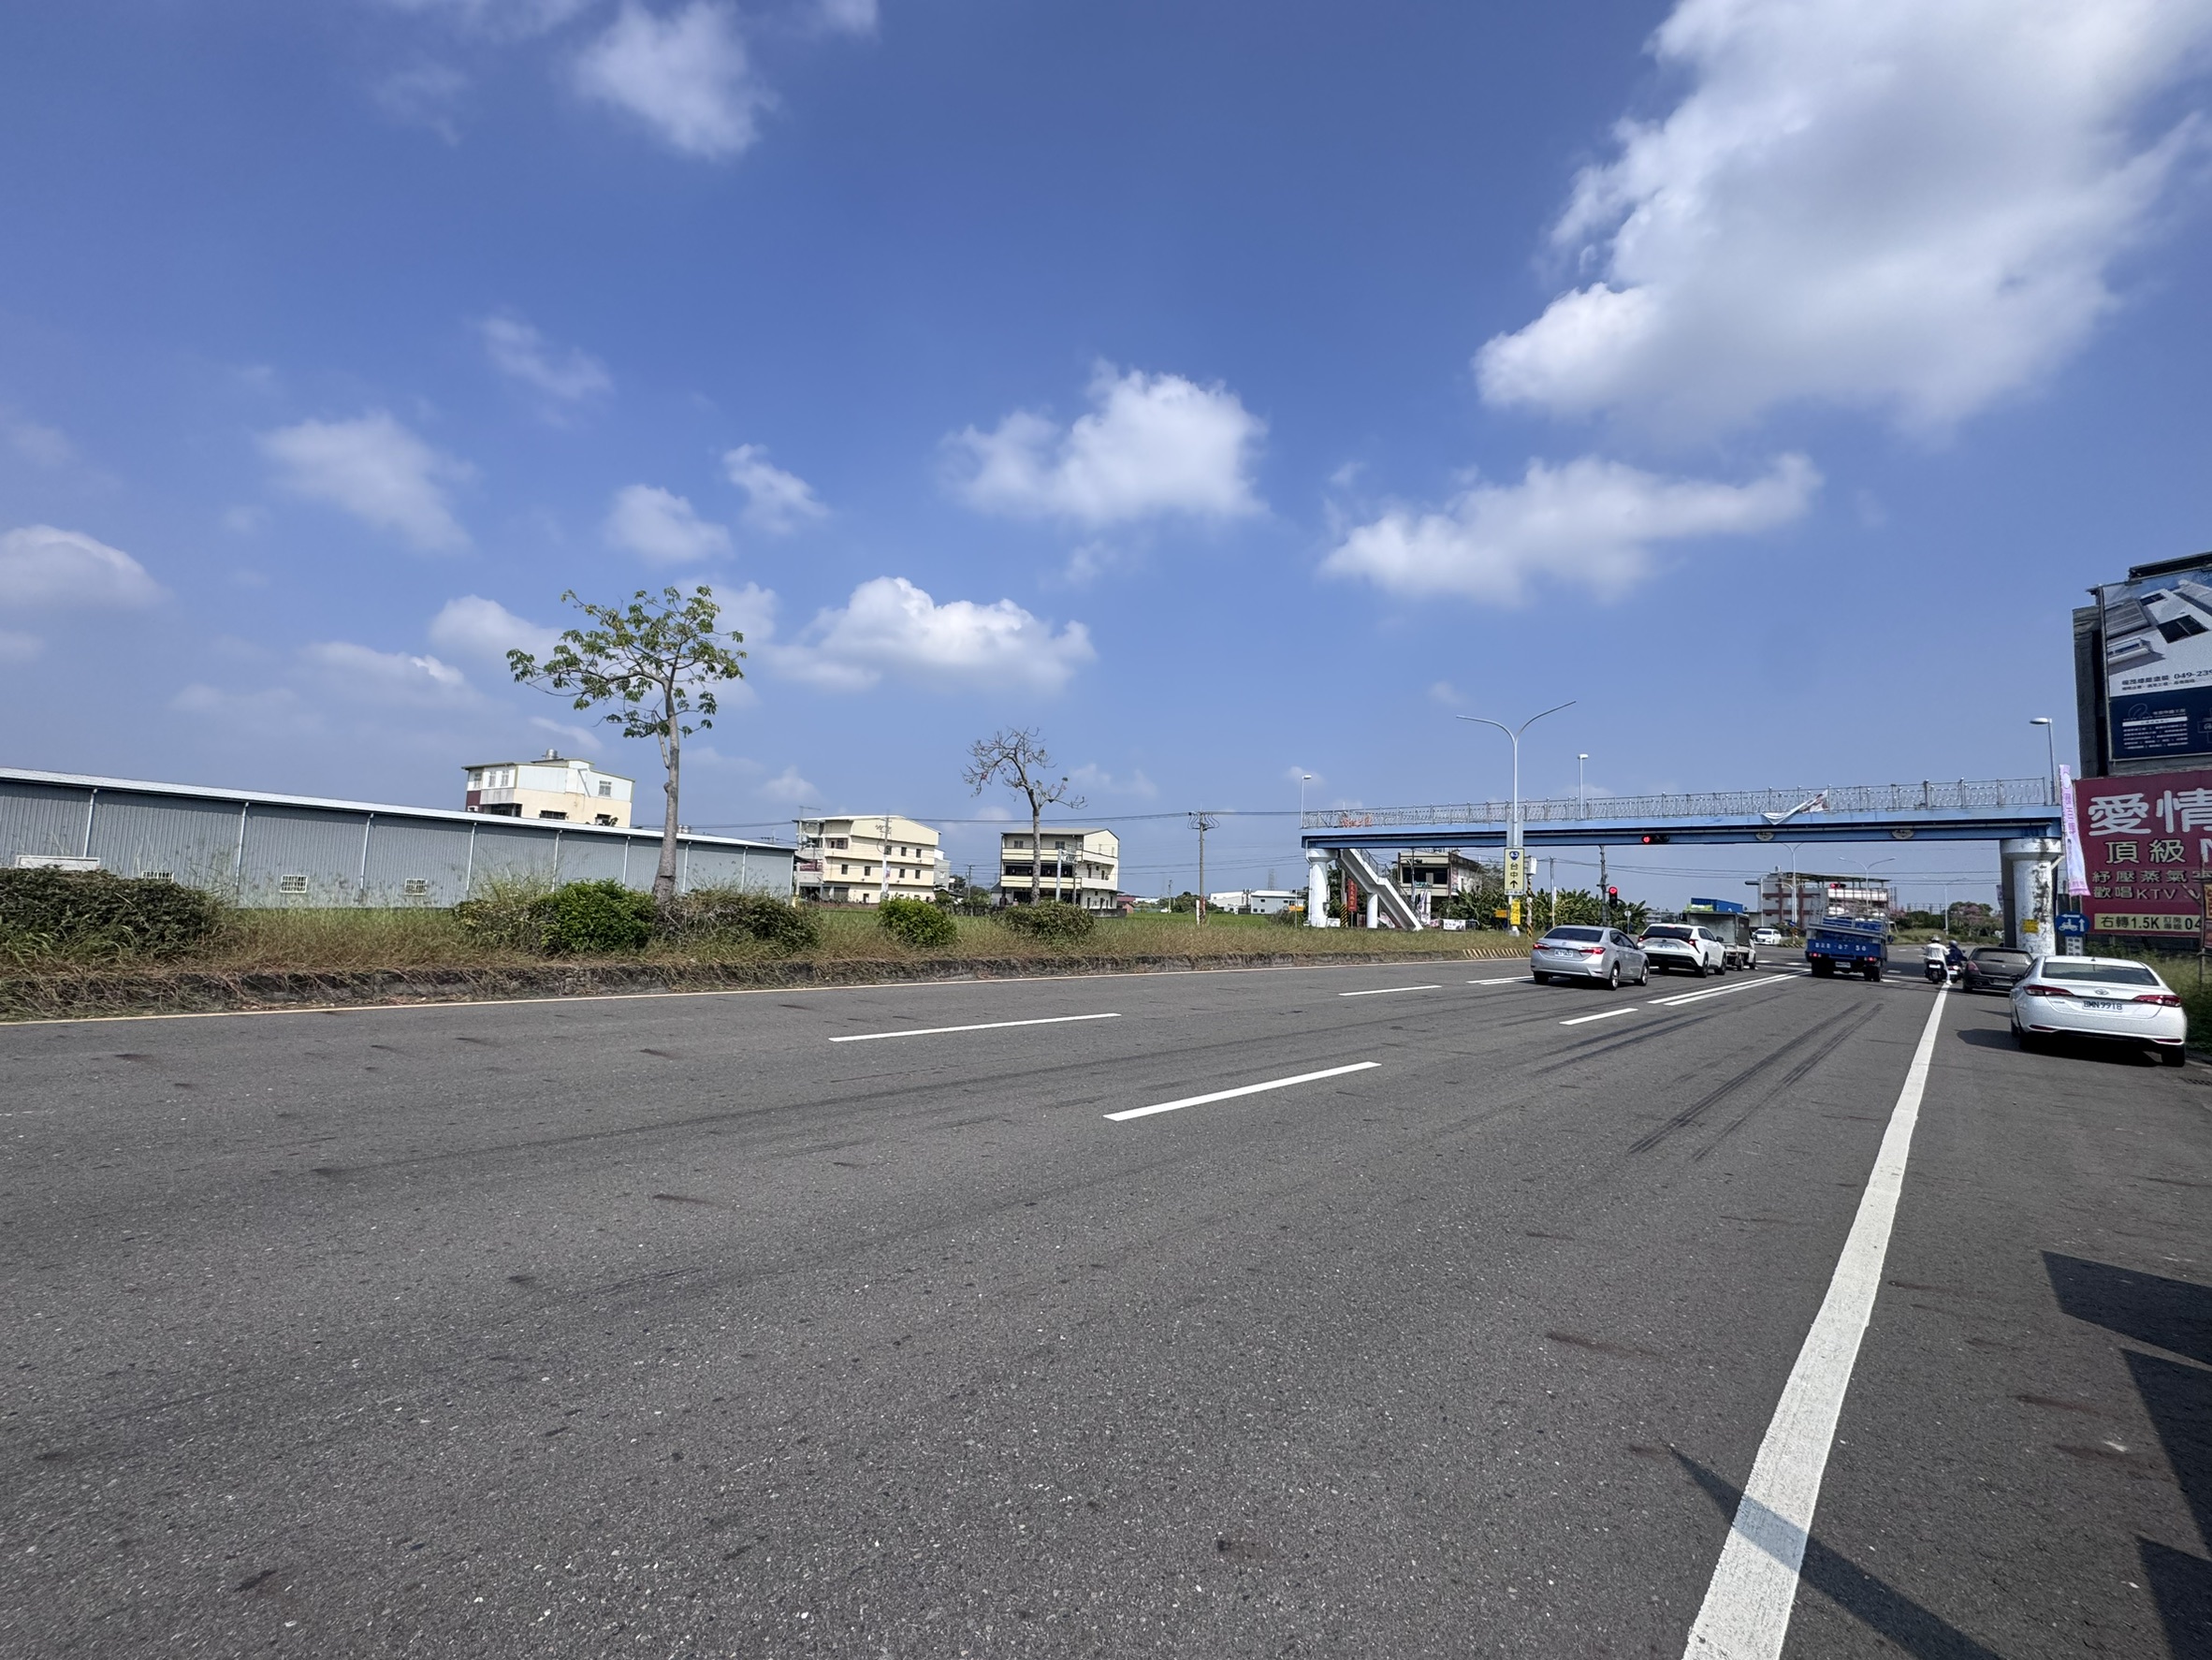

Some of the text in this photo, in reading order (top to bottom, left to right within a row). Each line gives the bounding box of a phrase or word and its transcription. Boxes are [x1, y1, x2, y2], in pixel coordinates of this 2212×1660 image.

[2088, 787, 2212, 837] 愛情
[2104, 838, 2186, 864] 頂級
[1509, 863, 1519, 879] 台中
